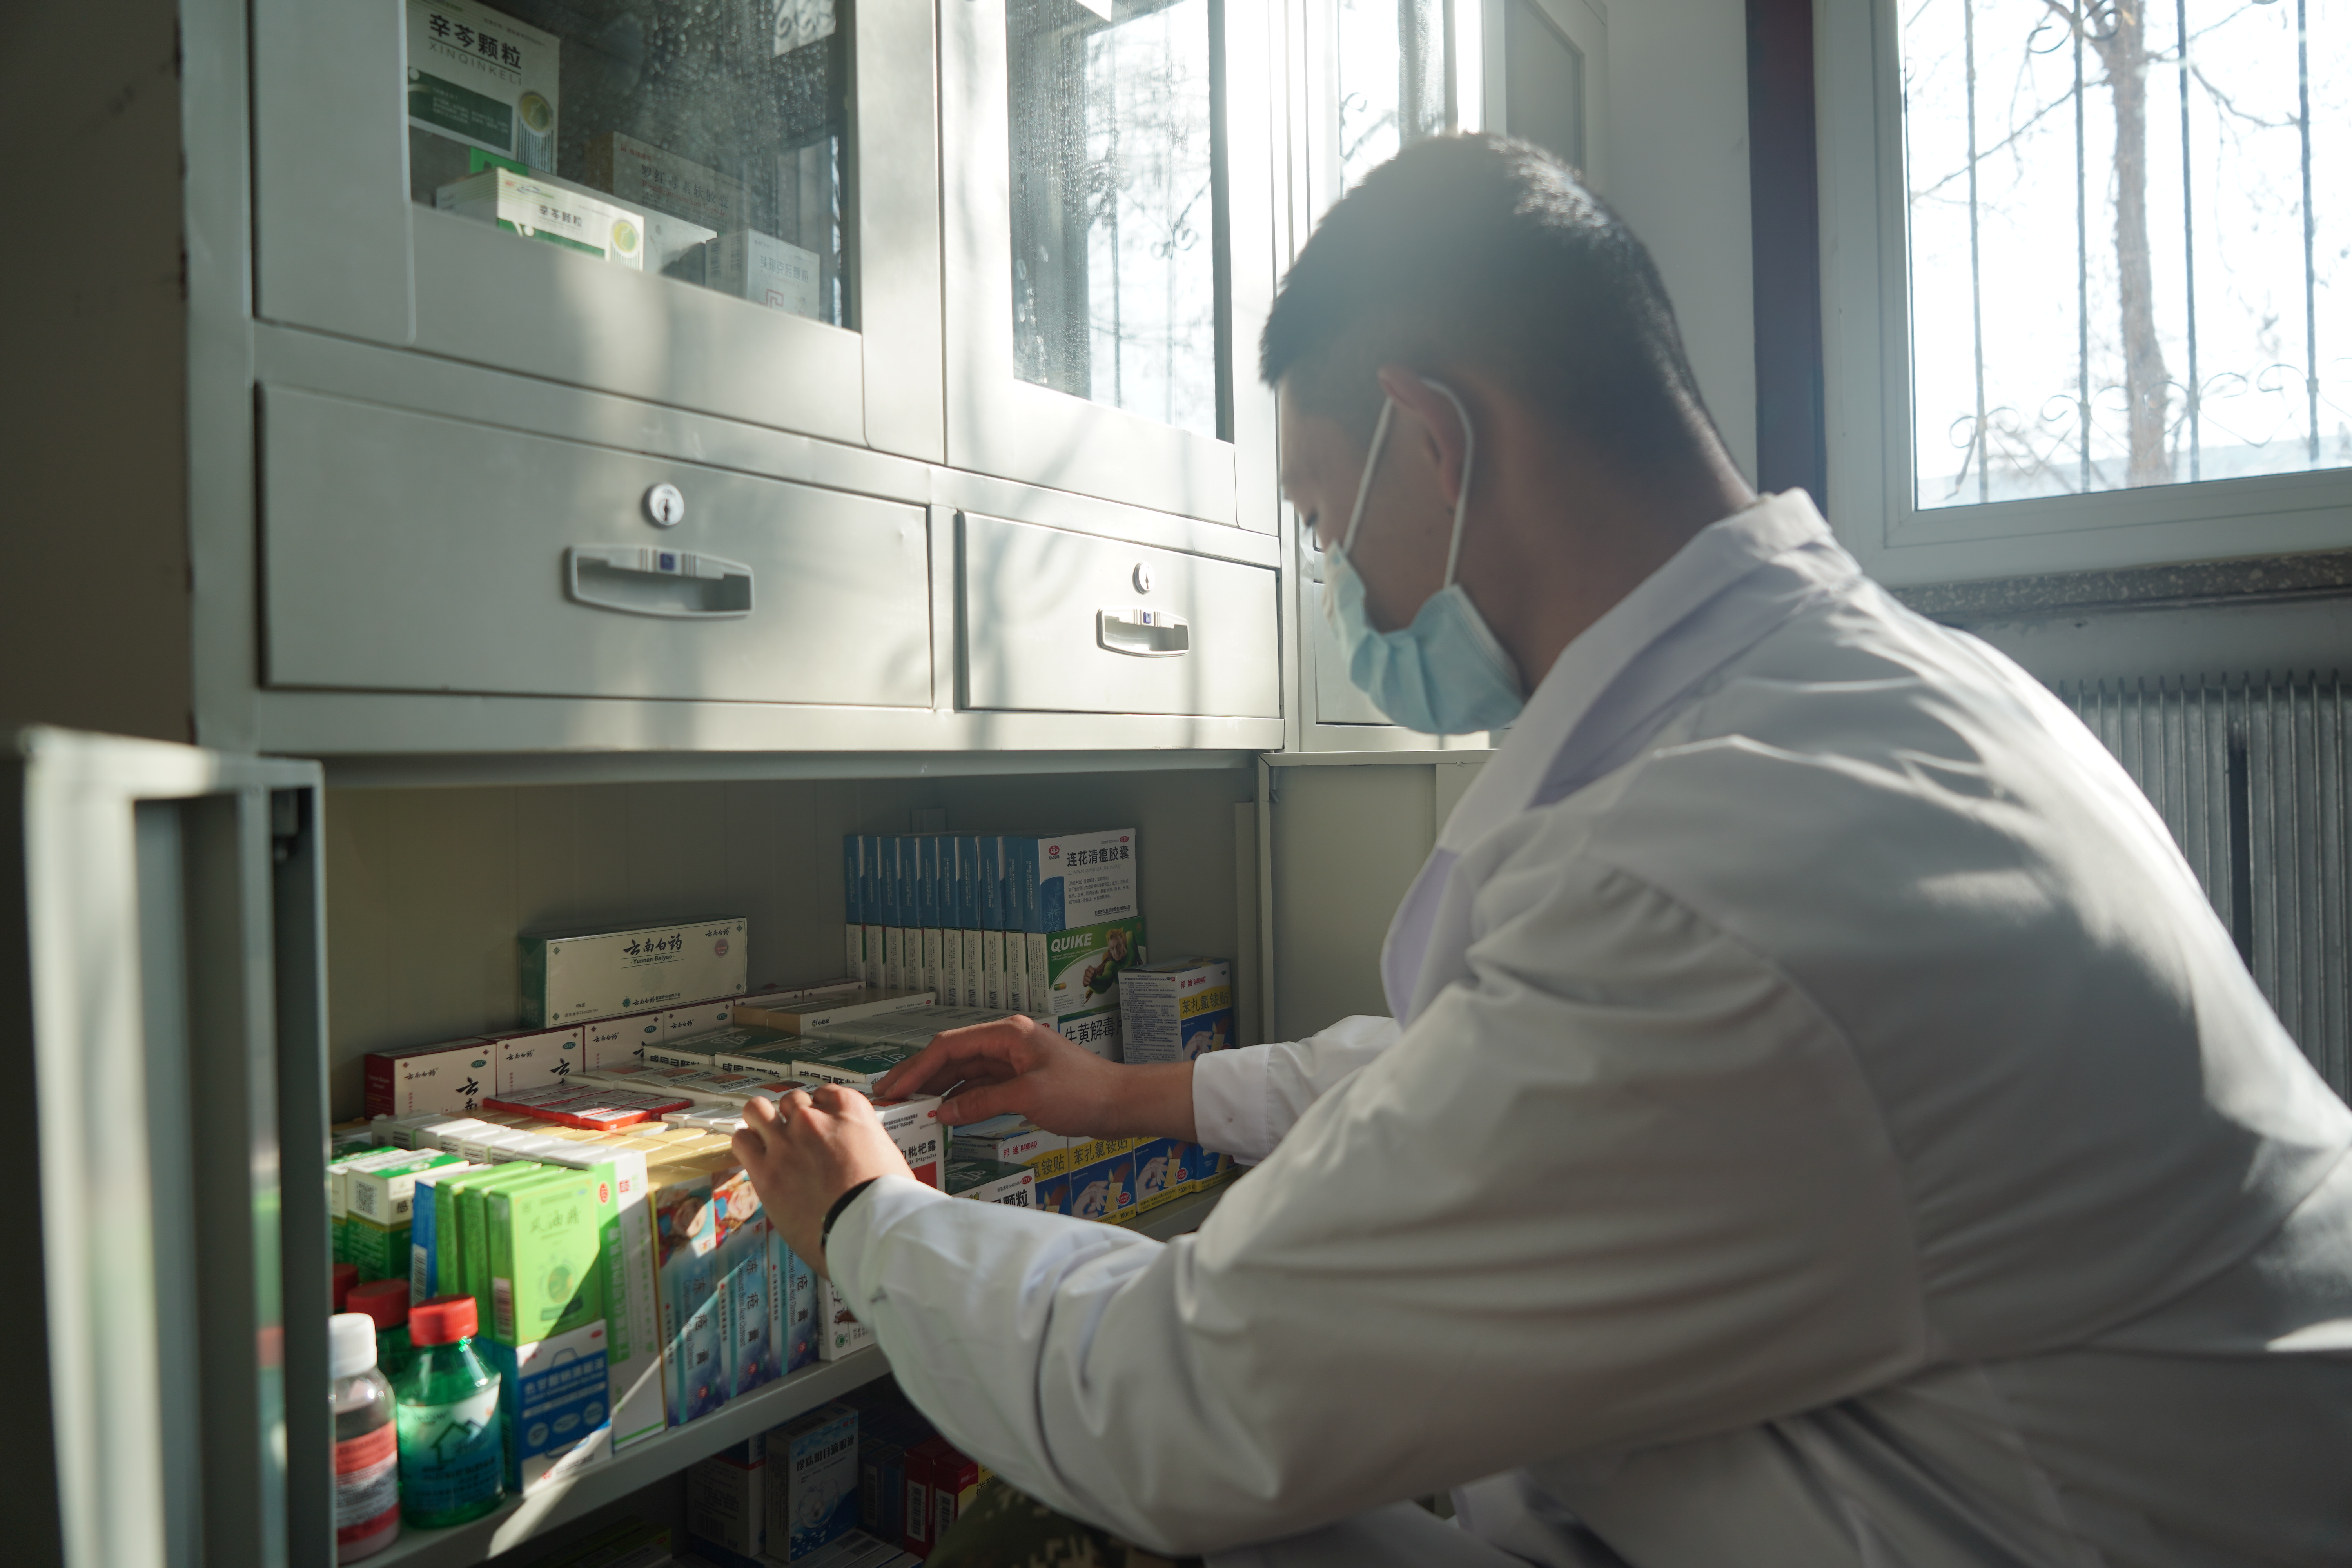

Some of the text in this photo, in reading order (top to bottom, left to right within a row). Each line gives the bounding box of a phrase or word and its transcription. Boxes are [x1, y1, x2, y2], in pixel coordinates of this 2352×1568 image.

[430, 13, 521, 69] 辛芩颗粒
[430, 41, 521, 86] XINQINKELI
[641, 164, 729, 209] 罗红霉素软胶囊
[539, 205, 583, 228] 辛芩颗粒
[1067, 845, 1129, 867] 连花清瘟胶囊
[705, 927, 729, 937] 云南白药
[623, 933, 682, 956] 云南白药
[1051, 933, 1093, 953] QUIKE
[1193, 976, 1206, 984] BAND-AID
[1182, 990, 1229, 1015] 苯扎氯铵贴
[670, 1020, 693, 1029] 云南白药
[593, 1033, 617, 1043] 云南白药
[506, 1050, 533, 1060] 云南白药
[404, 1068, 436, 1080] 云南白药
[1020, 1141, 1037, 1151] BAND-AID
[1074, 1138, 1127, 1165] 苯扎氯铵贴
[916, 1153, 936, 1163] Pipalu
[797, 1435, 854, 1472] 珍珠明目滴眼液
